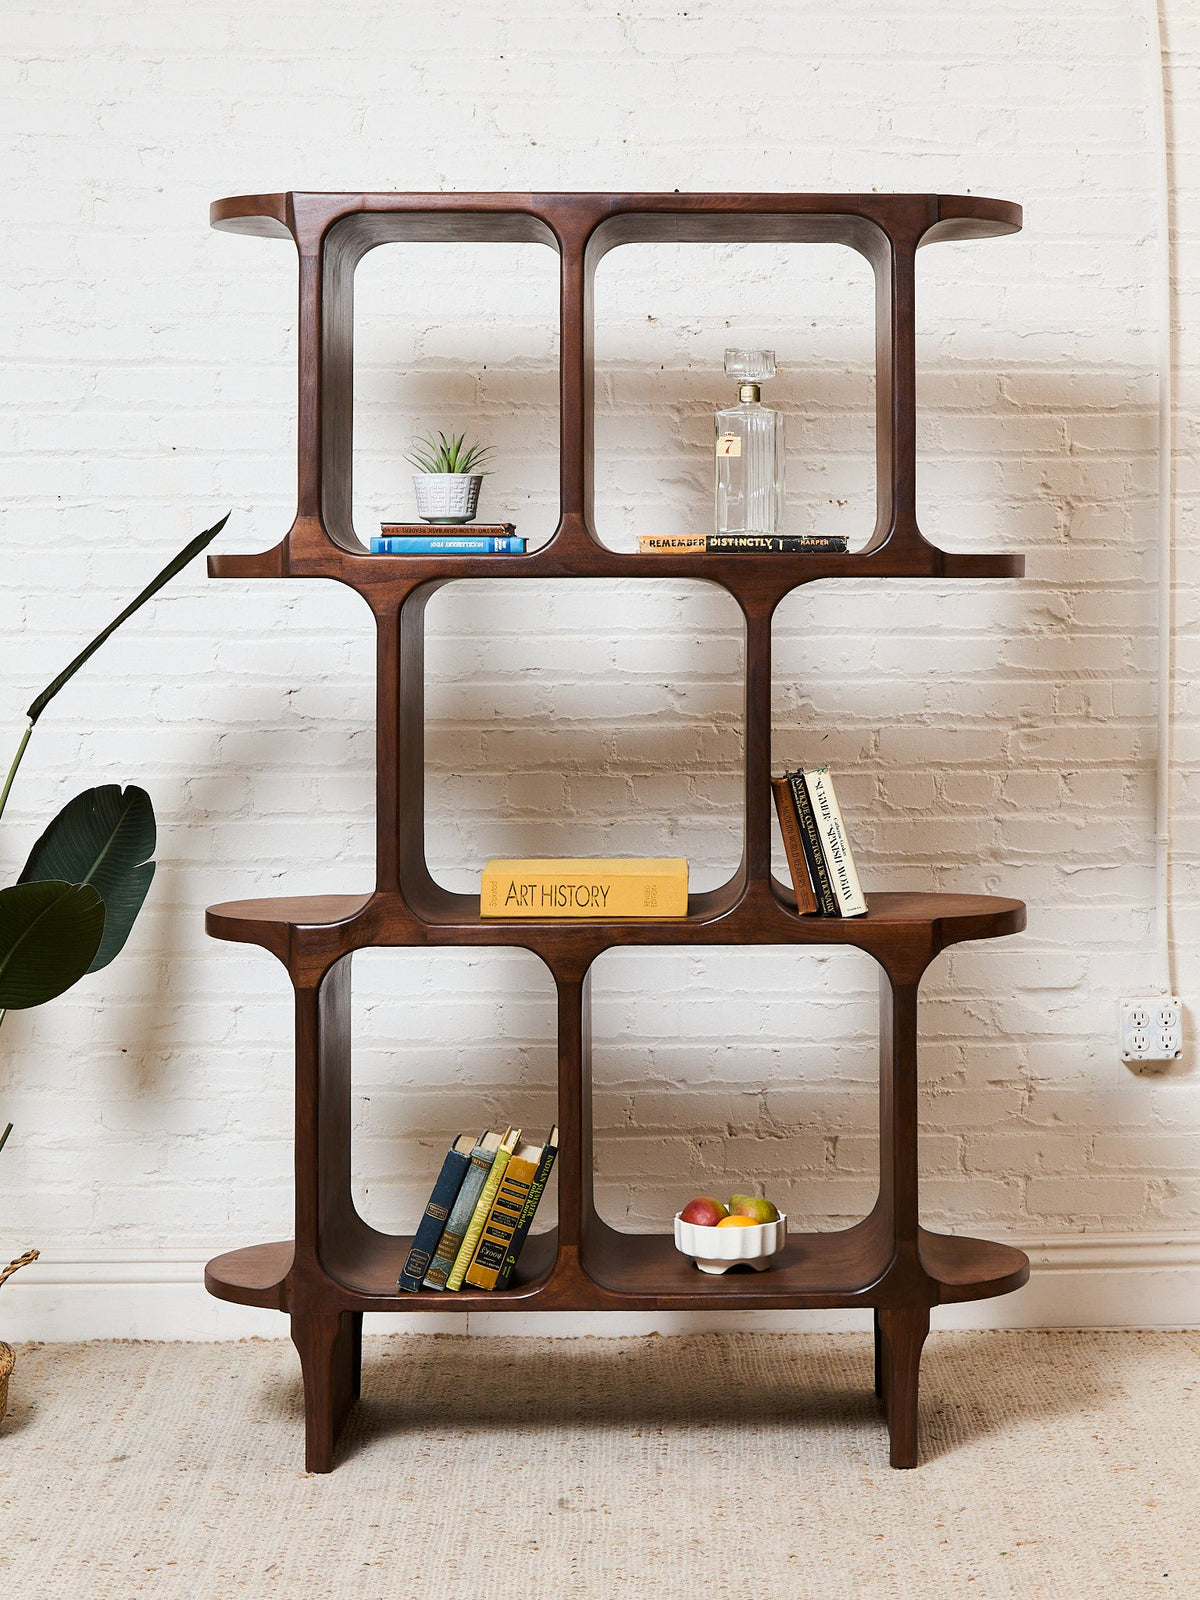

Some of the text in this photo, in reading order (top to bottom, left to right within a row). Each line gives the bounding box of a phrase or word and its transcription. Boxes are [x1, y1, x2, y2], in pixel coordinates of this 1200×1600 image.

[724, 439, 734, 454] 7
[649, 538, 774, 549] REMEMBER DISTINCTLY
[783, 805, 794, 833] MODERN
[834, 817, 842, 839] Catherine
[788, 834, 800, 858] WORLD
[794, 777, 811, 814] ANTIQUE
[817, 864, 835, 913] DICTIONARY
[815, 780, 852, 900] SUMMER SPANISH WOMAN
[793, 859, 807, 888] READERS
[504, 880, 611, 907] ART HISTORY
[650, 884, 658, 908] EDITION
[527, 1154, 554, 1217] INDIAN SUMMER
[528, 1180, 539, 1199] John
[516, 1199, 531, 1229] Knowles
[451, 1226, 481, 1285] TOMORROW'S
[474, 1180, 497, 1224] MIRACLE
[480, 1246, 502, 1260] BOOKS
